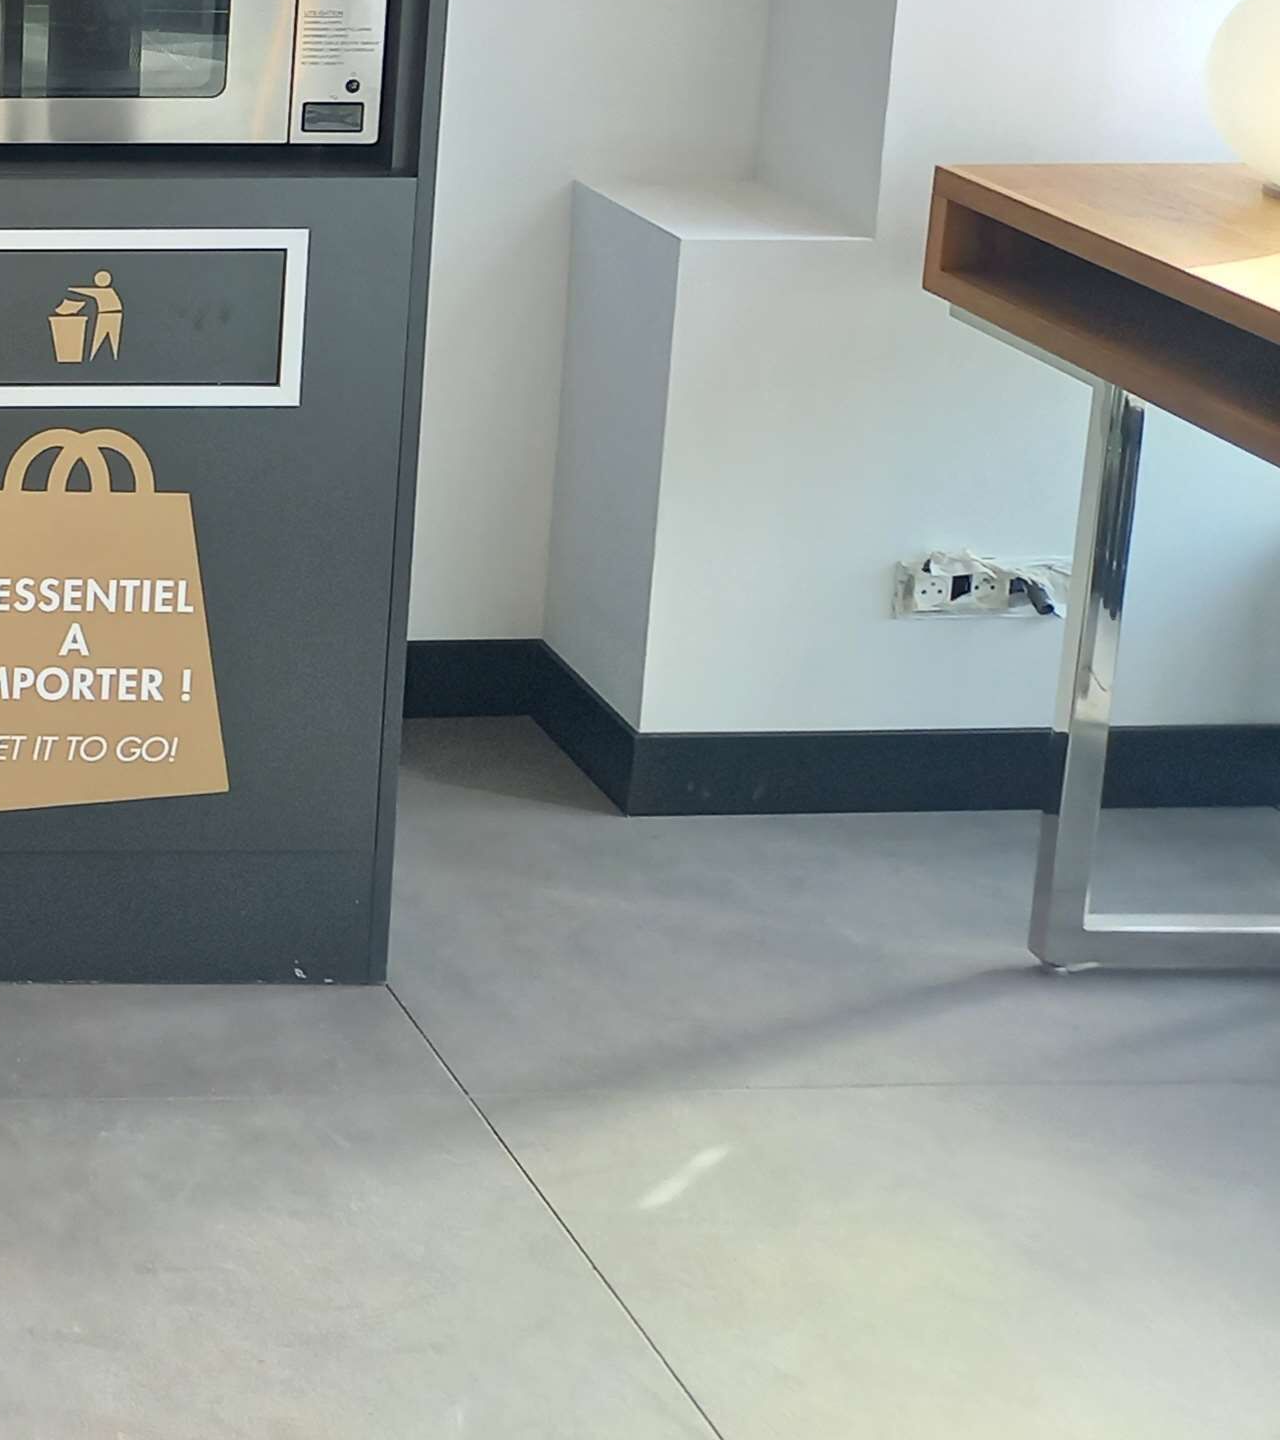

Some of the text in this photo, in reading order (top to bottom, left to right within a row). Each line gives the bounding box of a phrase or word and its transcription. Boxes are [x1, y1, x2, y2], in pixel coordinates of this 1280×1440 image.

[58, 622, 90, 657] A
[180, 668, 192, 702] !
[32, 735, 58, 761] IT
[67, 735, 108, 762] TO
[116, 735, 179, 762] GO!
